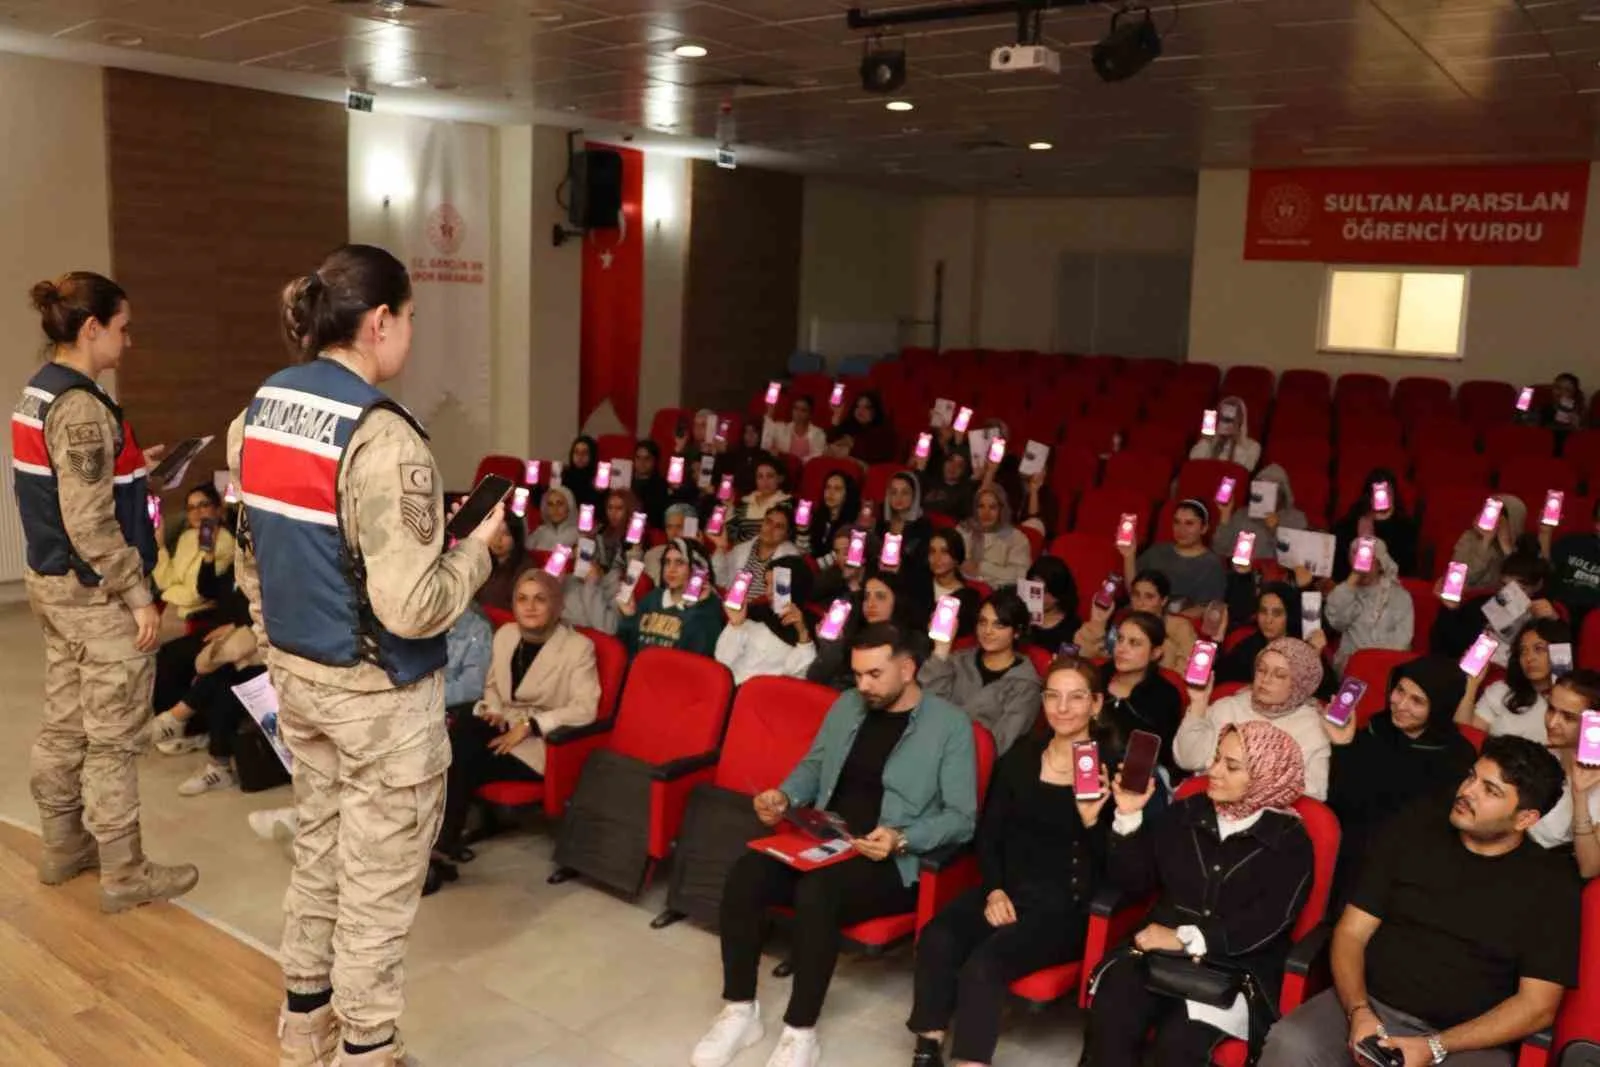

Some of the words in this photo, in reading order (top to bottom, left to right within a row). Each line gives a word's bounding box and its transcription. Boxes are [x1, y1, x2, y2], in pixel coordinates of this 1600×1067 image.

[1324, 193, 1413, 213] SULTAN
[1418, 191, 1570, 212] ALPARSLAN
[1342, 217, 1448, 241] ÖĞRENCİ
[1453, 222, 1544, 242] YURDU
